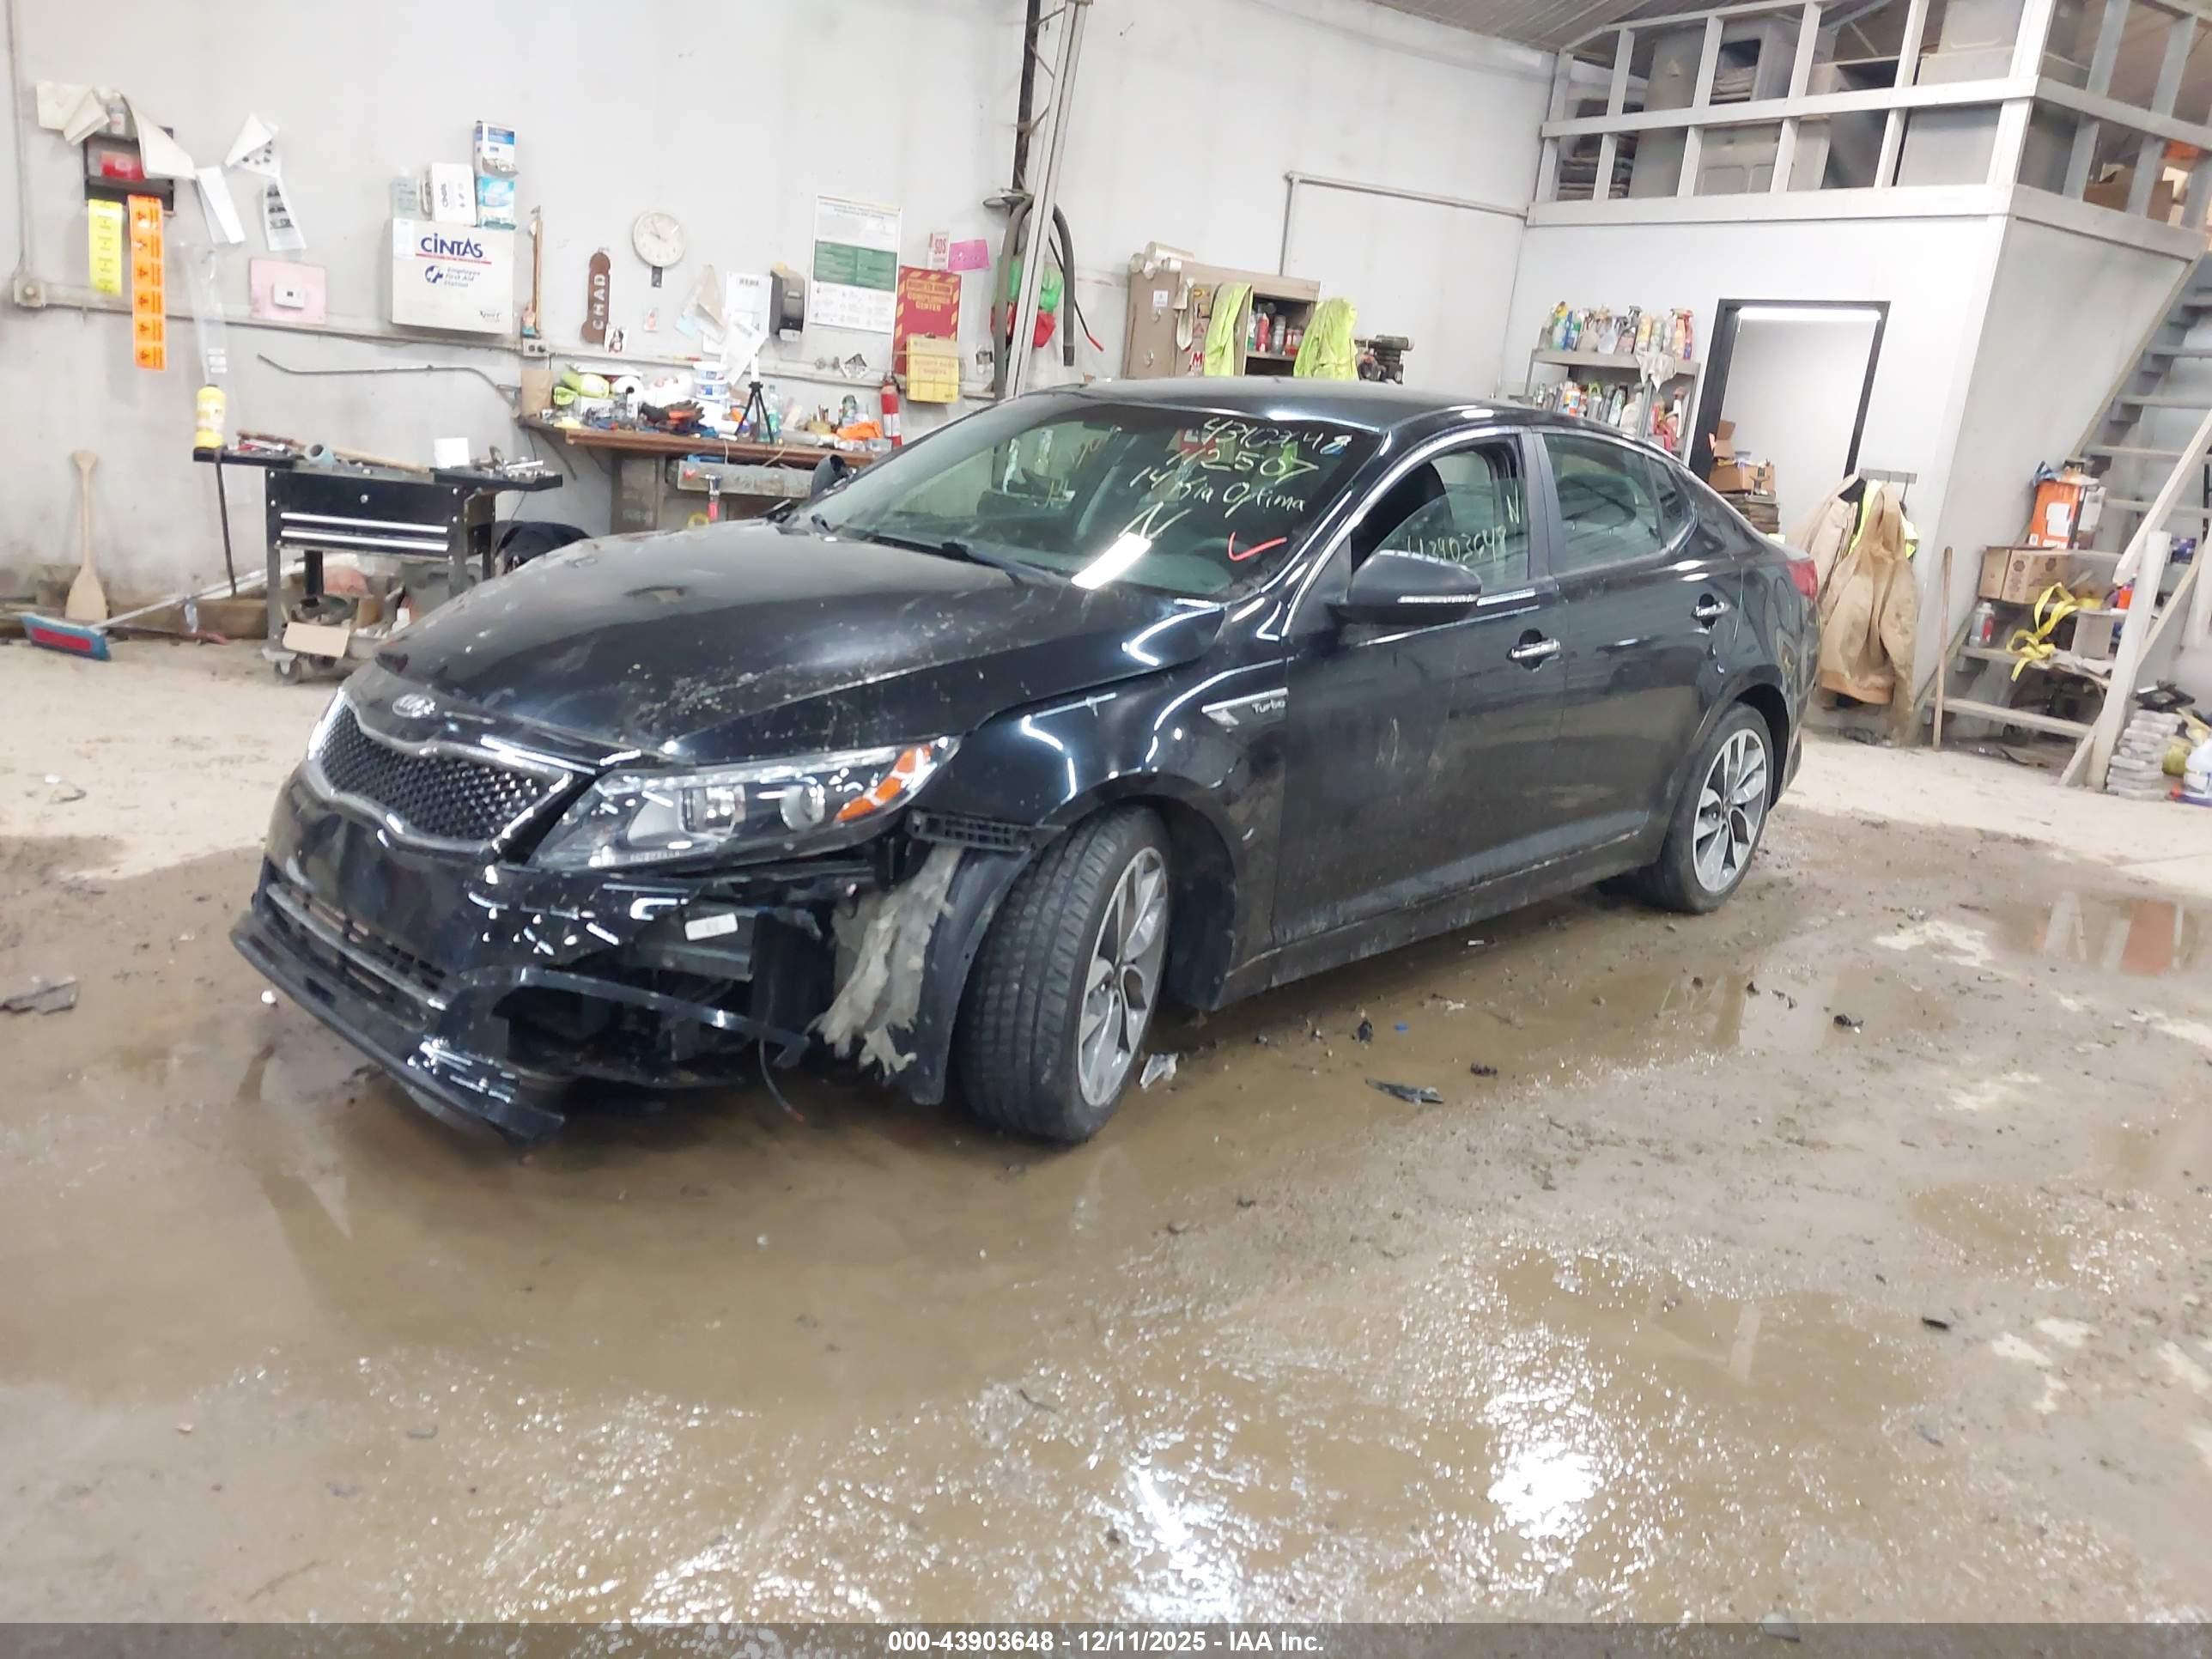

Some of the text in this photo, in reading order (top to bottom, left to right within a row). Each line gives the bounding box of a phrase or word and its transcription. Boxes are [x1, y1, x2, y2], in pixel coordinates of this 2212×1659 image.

[421, 234, 483, 258] CINTAS
[592, 274, 605, 331] CHAD
[1251, 699, 1286, 714] Turbo
